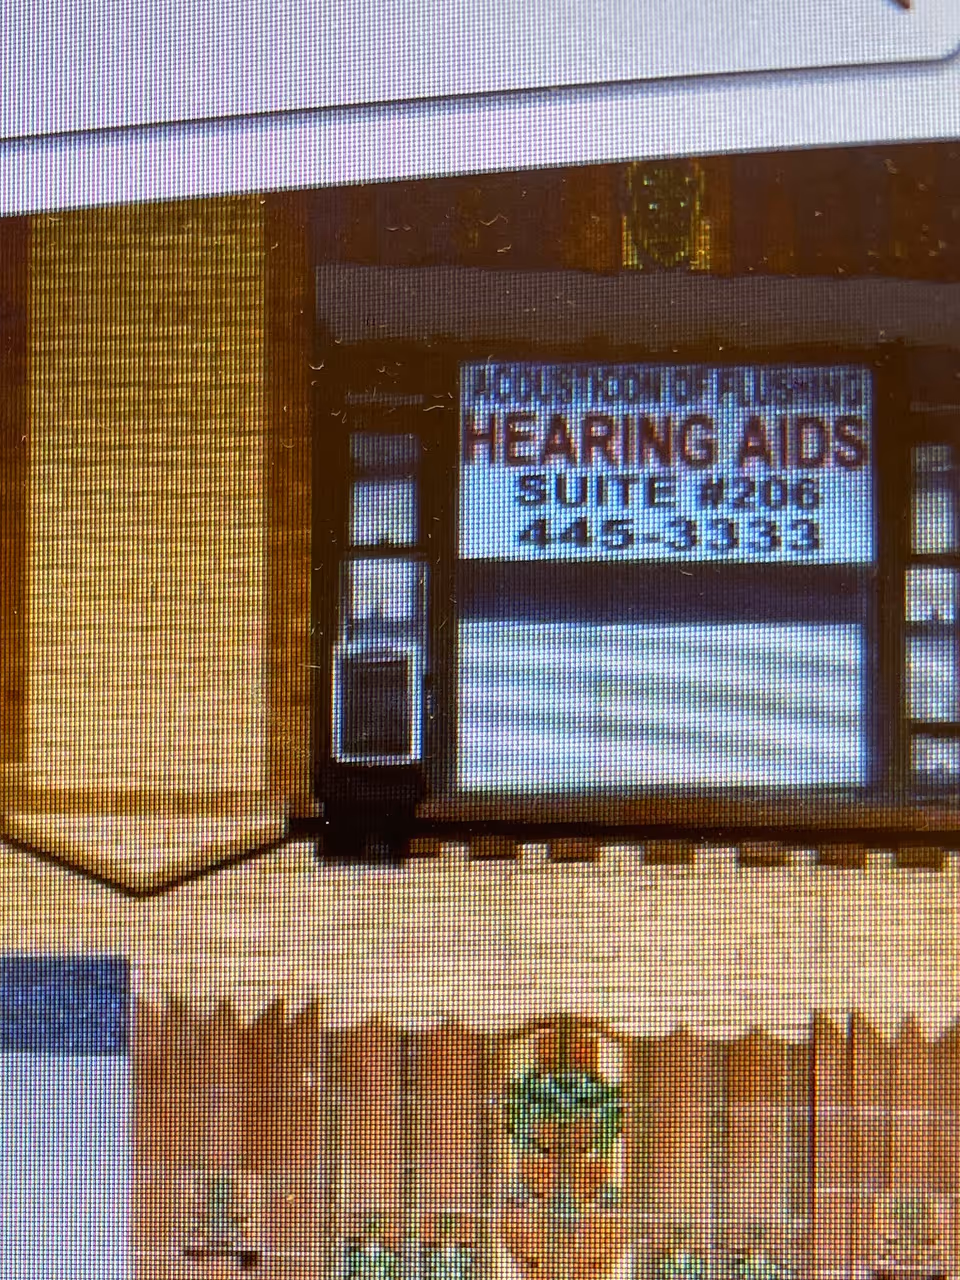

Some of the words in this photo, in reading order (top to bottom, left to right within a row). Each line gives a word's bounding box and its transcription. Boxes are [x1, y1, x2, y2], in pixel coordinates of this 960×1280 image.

[670, 369, 710, 403] OF
[717, 371, 863, 407] FLUSHING
[463, 411, 717, 469] HEARING
[737, 415, 869, 471] AIDS
[515, 473, 677, 508] SUITE
[696, 476, 821, 510] #206
[517, 517, 822, 553] 445-3333
